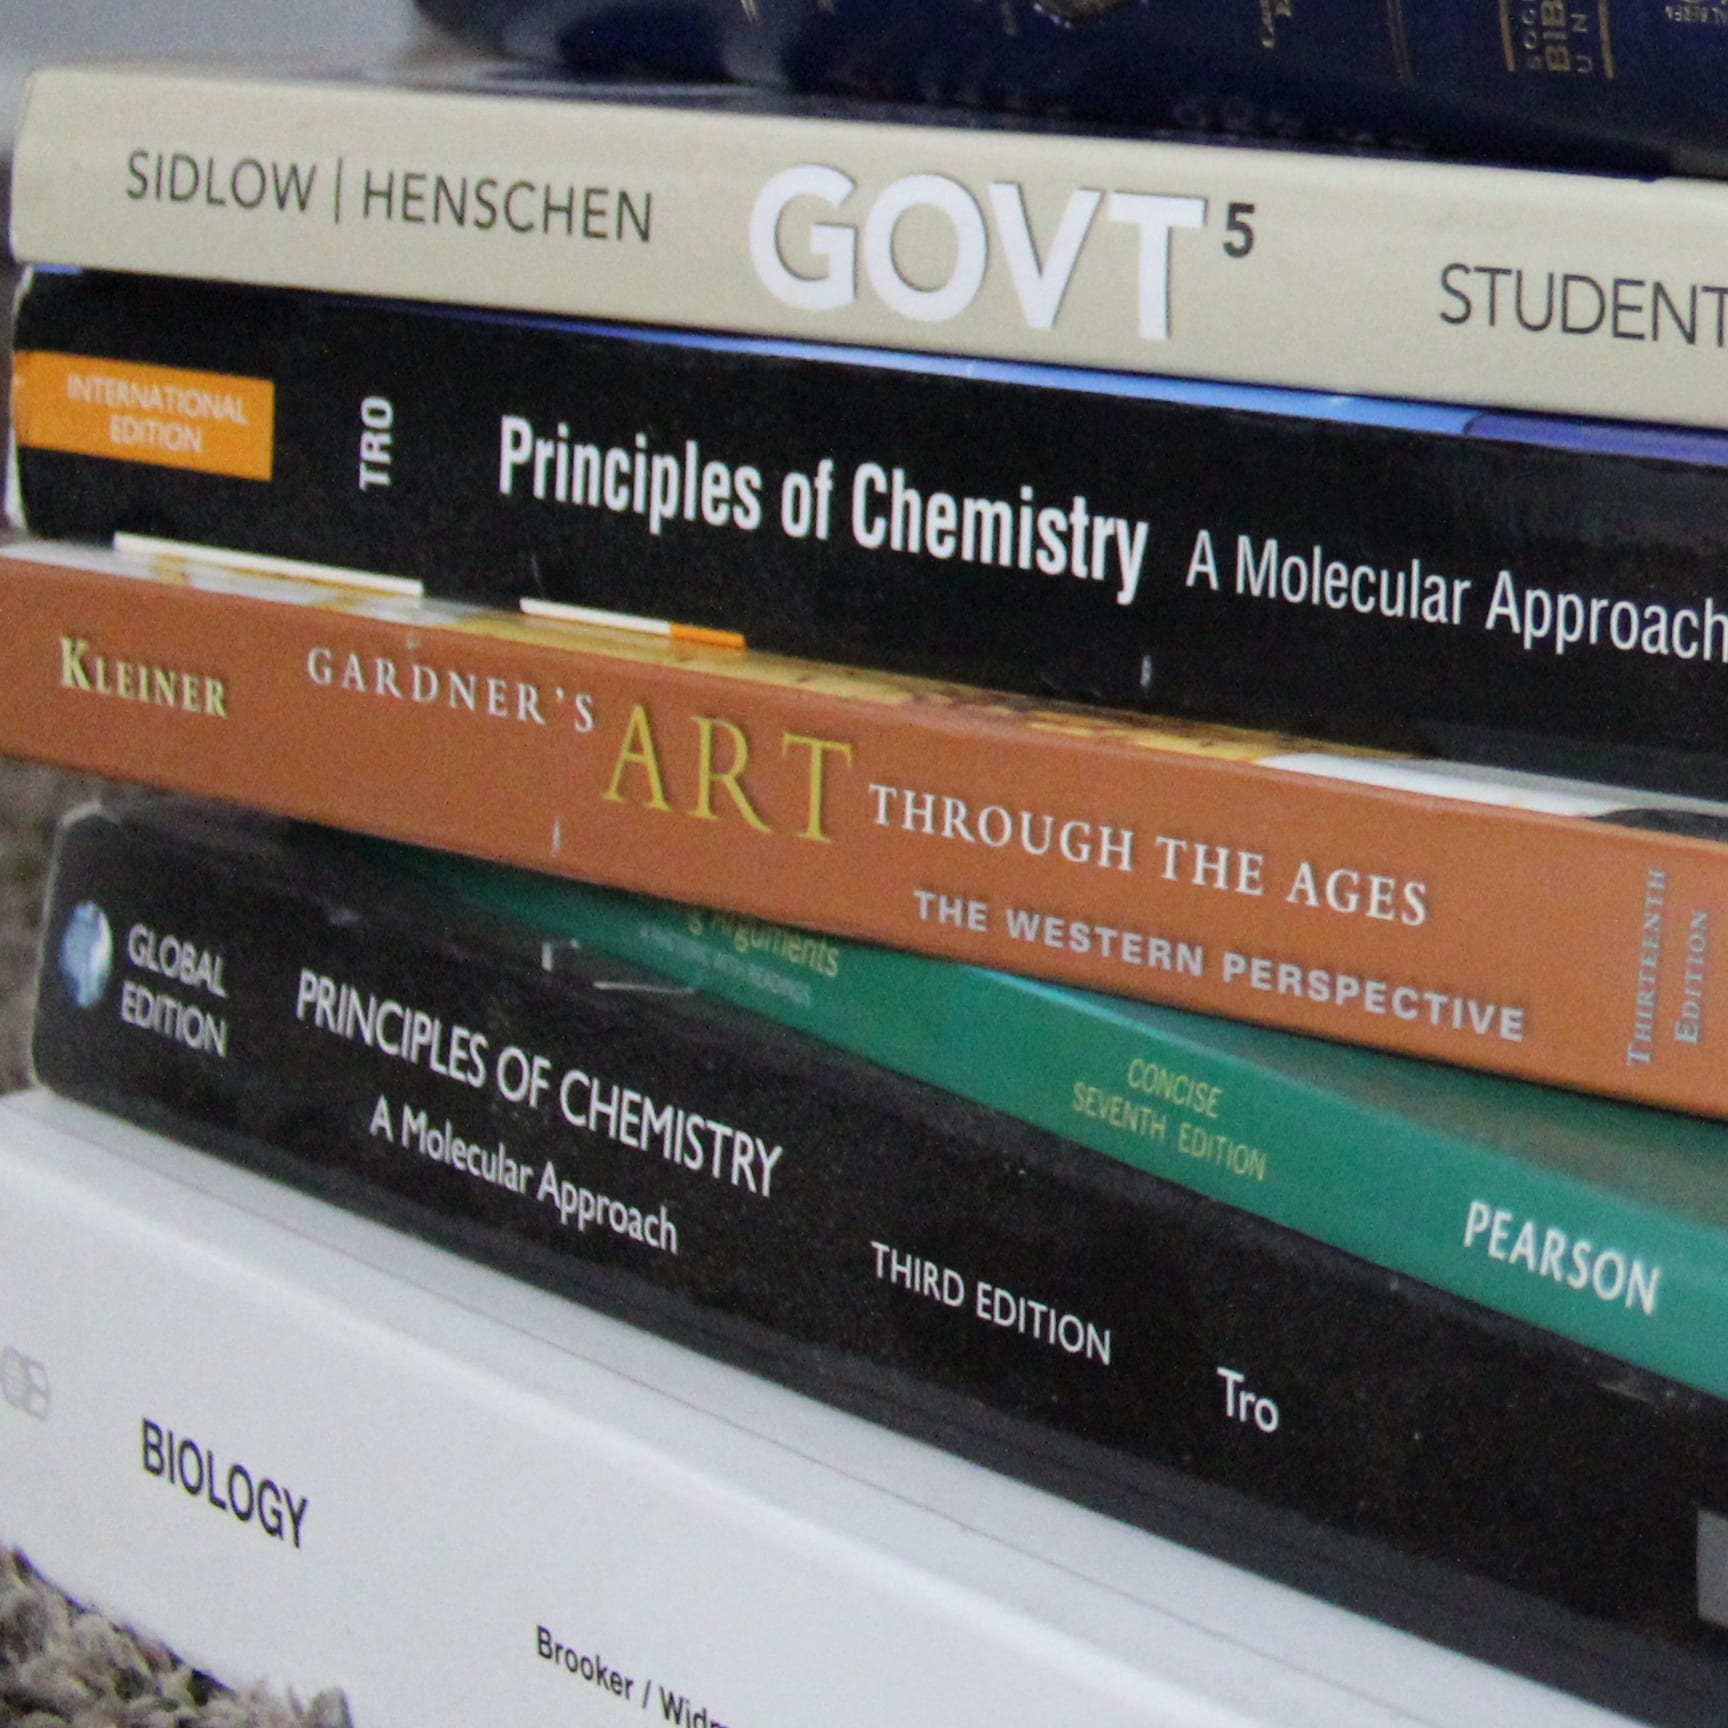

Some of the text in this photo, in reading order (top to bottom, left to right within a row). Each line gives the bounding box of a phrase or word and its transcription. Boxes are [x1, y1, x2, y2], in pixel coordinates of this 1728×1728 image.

[126, 149, 315, 213] SIDLOW
[362, 169, 655, 244] HENSCHEN
[748, 163, 1257, 341] GOVT 5
[65, 372, 249, 427] INTERNATIONAL
[109, 417, 203, 455] EDITION
[358, 394, 393, 491] TRO
[498, 413, 1150, 605] Principles of Chemistry
[1186, 529, 1219, 591] A
[1236, 532, 1472, 626] Molecular
[604, 703, 853, 843] ART
[868, 781, 1428, 927] THROUGH THE AGES
[128, 923, 229, 1000] GLOBAL
[914, 889, 1525, 1042] THE WESTERN PERSPECTIVE
[121, 981, 229, 1058] EDITION
[296, 968, 784, 1198] PRINCIPLES OF CHEMISTRY
[1072, 1082, 1268, 1184] SEVENTH EDITION
[1129, 1055, 1220, 1120] CONCISE
[369, 1094, 680, 1254] A Molecular Approach
[870, 1240, 1112, 1366] THIRD EDITION
[1464, 1198, 1661, 1316] PEARSON
[1217, 1366, 1280, 1433] Tro
[141, 1415, 309, 1550] BIOLOGY
[536, 1624, 635, 1701] Brooker
